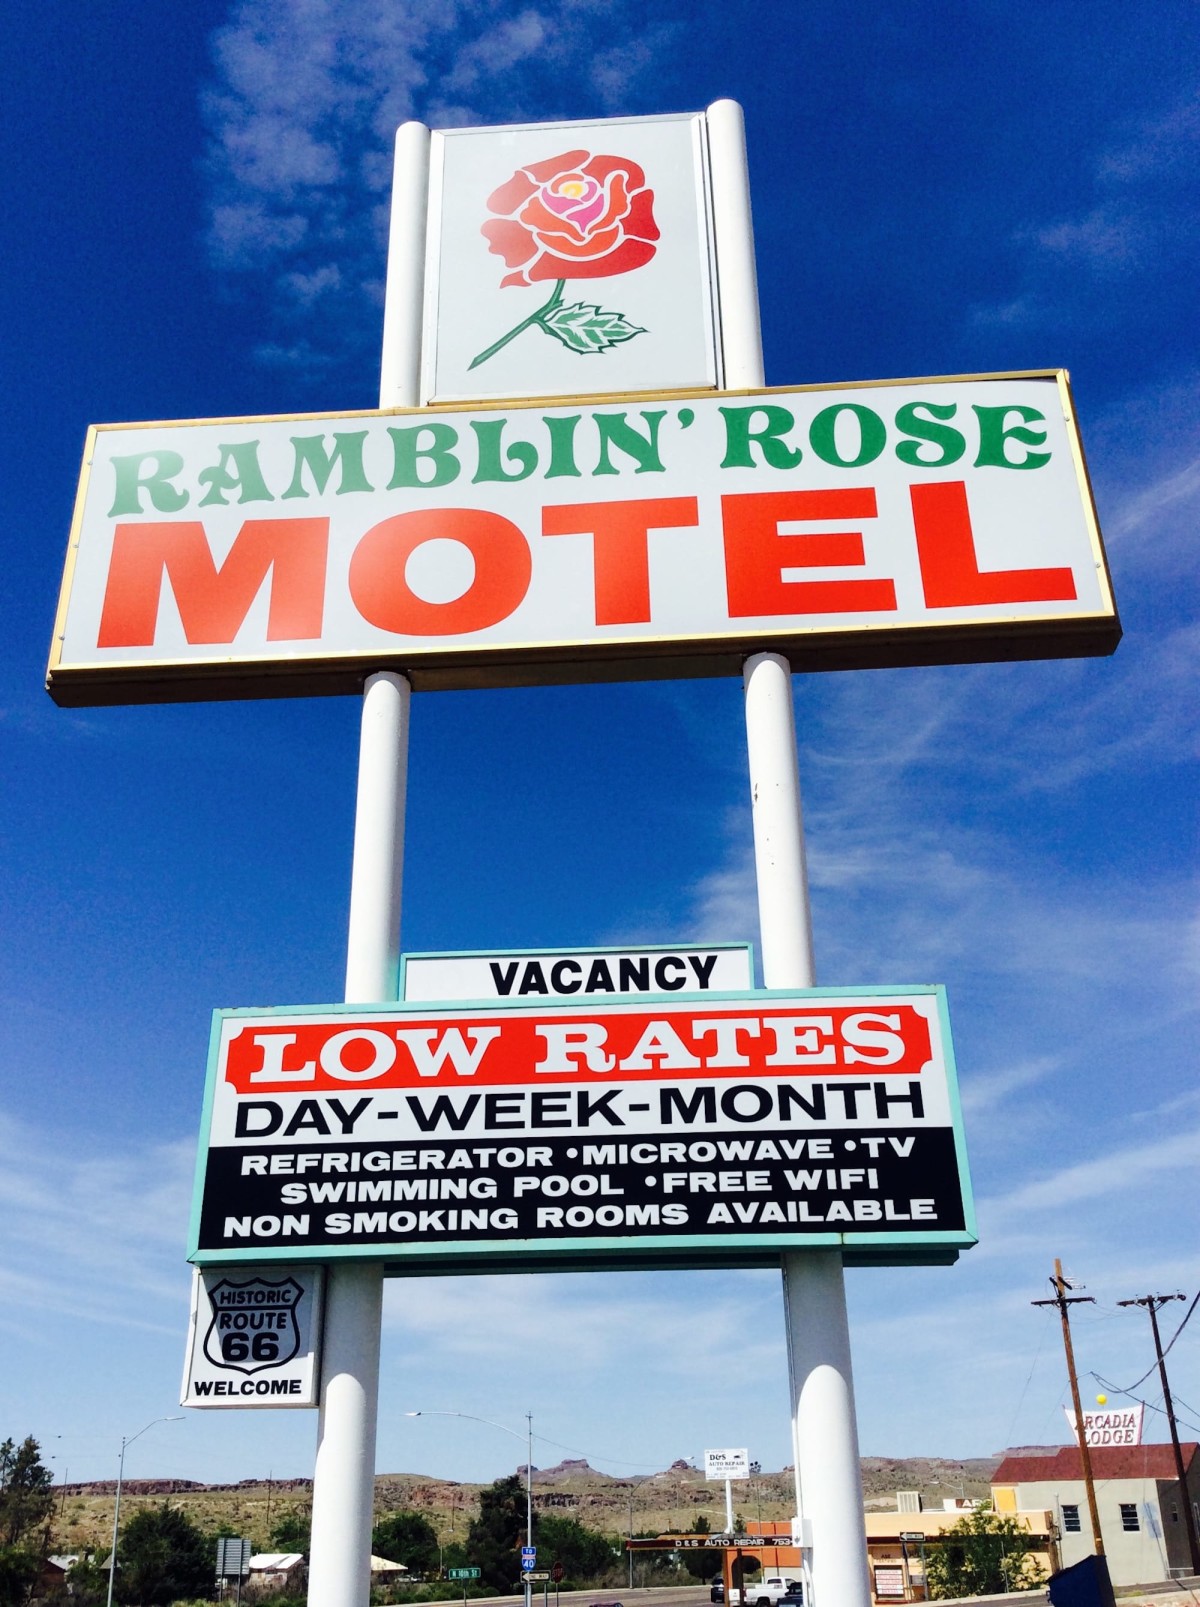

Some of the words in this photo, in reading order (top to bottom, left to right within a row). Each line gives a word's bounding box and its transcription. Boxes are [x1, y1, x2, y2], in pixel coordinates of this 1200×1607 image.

[107, 408, 695, 517] RAMBLIN'
[718, 401, 1052, 470] ROSE
[97, 480, 1077, 648] MOTEL
[489, 955, 718, 995] VACANCY
[249, 1026, 501, 1083] LOW
[535, 1012, 905, 1074] RATES
[234, 1081, 925, 1138] DAY-WEEK-MONTH
[241, 1146, 553, 1175] REFRIGERATOR
[280, 1177, 498, 1205] SWIMMING
[513, 1174, 624, 1198] POOL
[784, 1168, 879, 1191] WIFI
[223, 1214, 310, 1238] NON
[324, 1208, 518, 1235] SMOKING
[537, 1204, 688, 1228] ROOMS
[706, 1199, 938, 1224] AVAILABLE
[220, 1289, 292, 1304] HISTORIC
[219, 1312, 287, 1330] ROUTE
[222, 1332, 279, 1362] 66
[194, 1379, 302, 1396] WELCOME
[523, 1560, 534, 1568] 40
